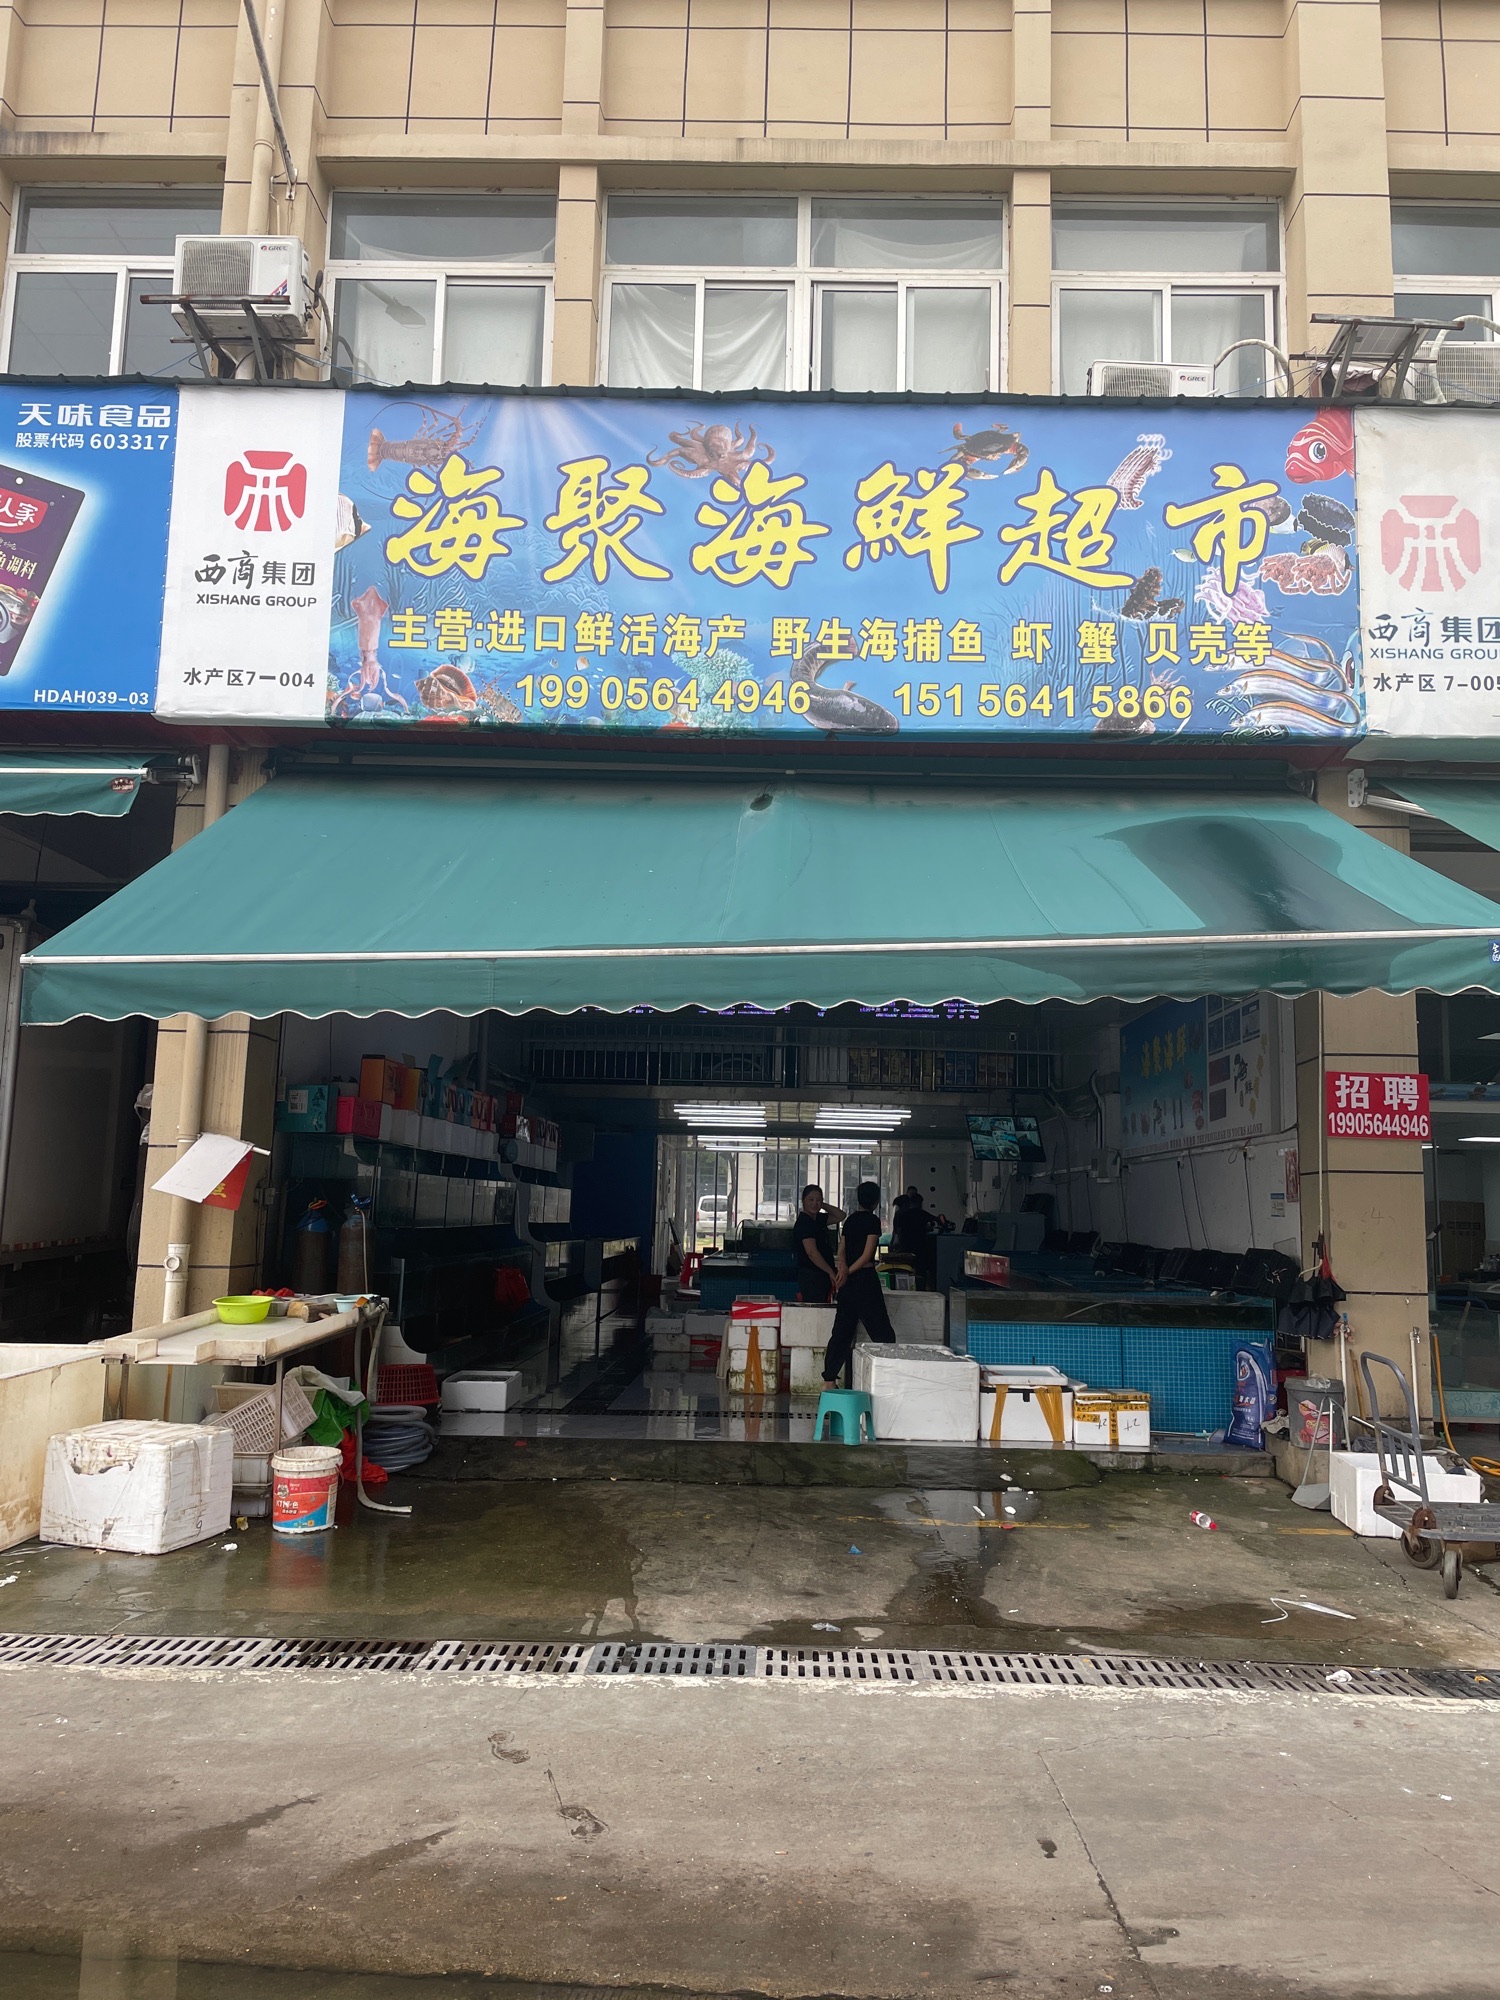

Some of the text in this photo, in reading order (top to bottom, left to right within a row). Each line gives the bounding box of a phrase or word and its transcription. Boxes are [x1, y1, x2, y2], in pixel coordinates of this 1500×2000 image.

[18, 403, 171, 428] 天味食品
[15, 433, 170, 450] 股票代码 603317
[0, 495, 38, 524] 人家
[194, 550, 315, 589] 西商集团
[196, 593, 317, 608] XISHANG GROUP
[1368, 607, 1500, 647] 西商集团
[771, 617, 986, 664] 野生海捕鱼
[1011, 619, 1052, 664] 虾
[1077, 620, 1118, 666] 蟹
[1145, 620, 1274, 666] 贝壳等
[1370, 648, 1500, 660] XISHANG GROU
[34, 689, 150, 705] HDAH039-03
[1335, 1074, 1419, 1111] 招聘
[1329, 1112, 1428, 1136] 19905644946
